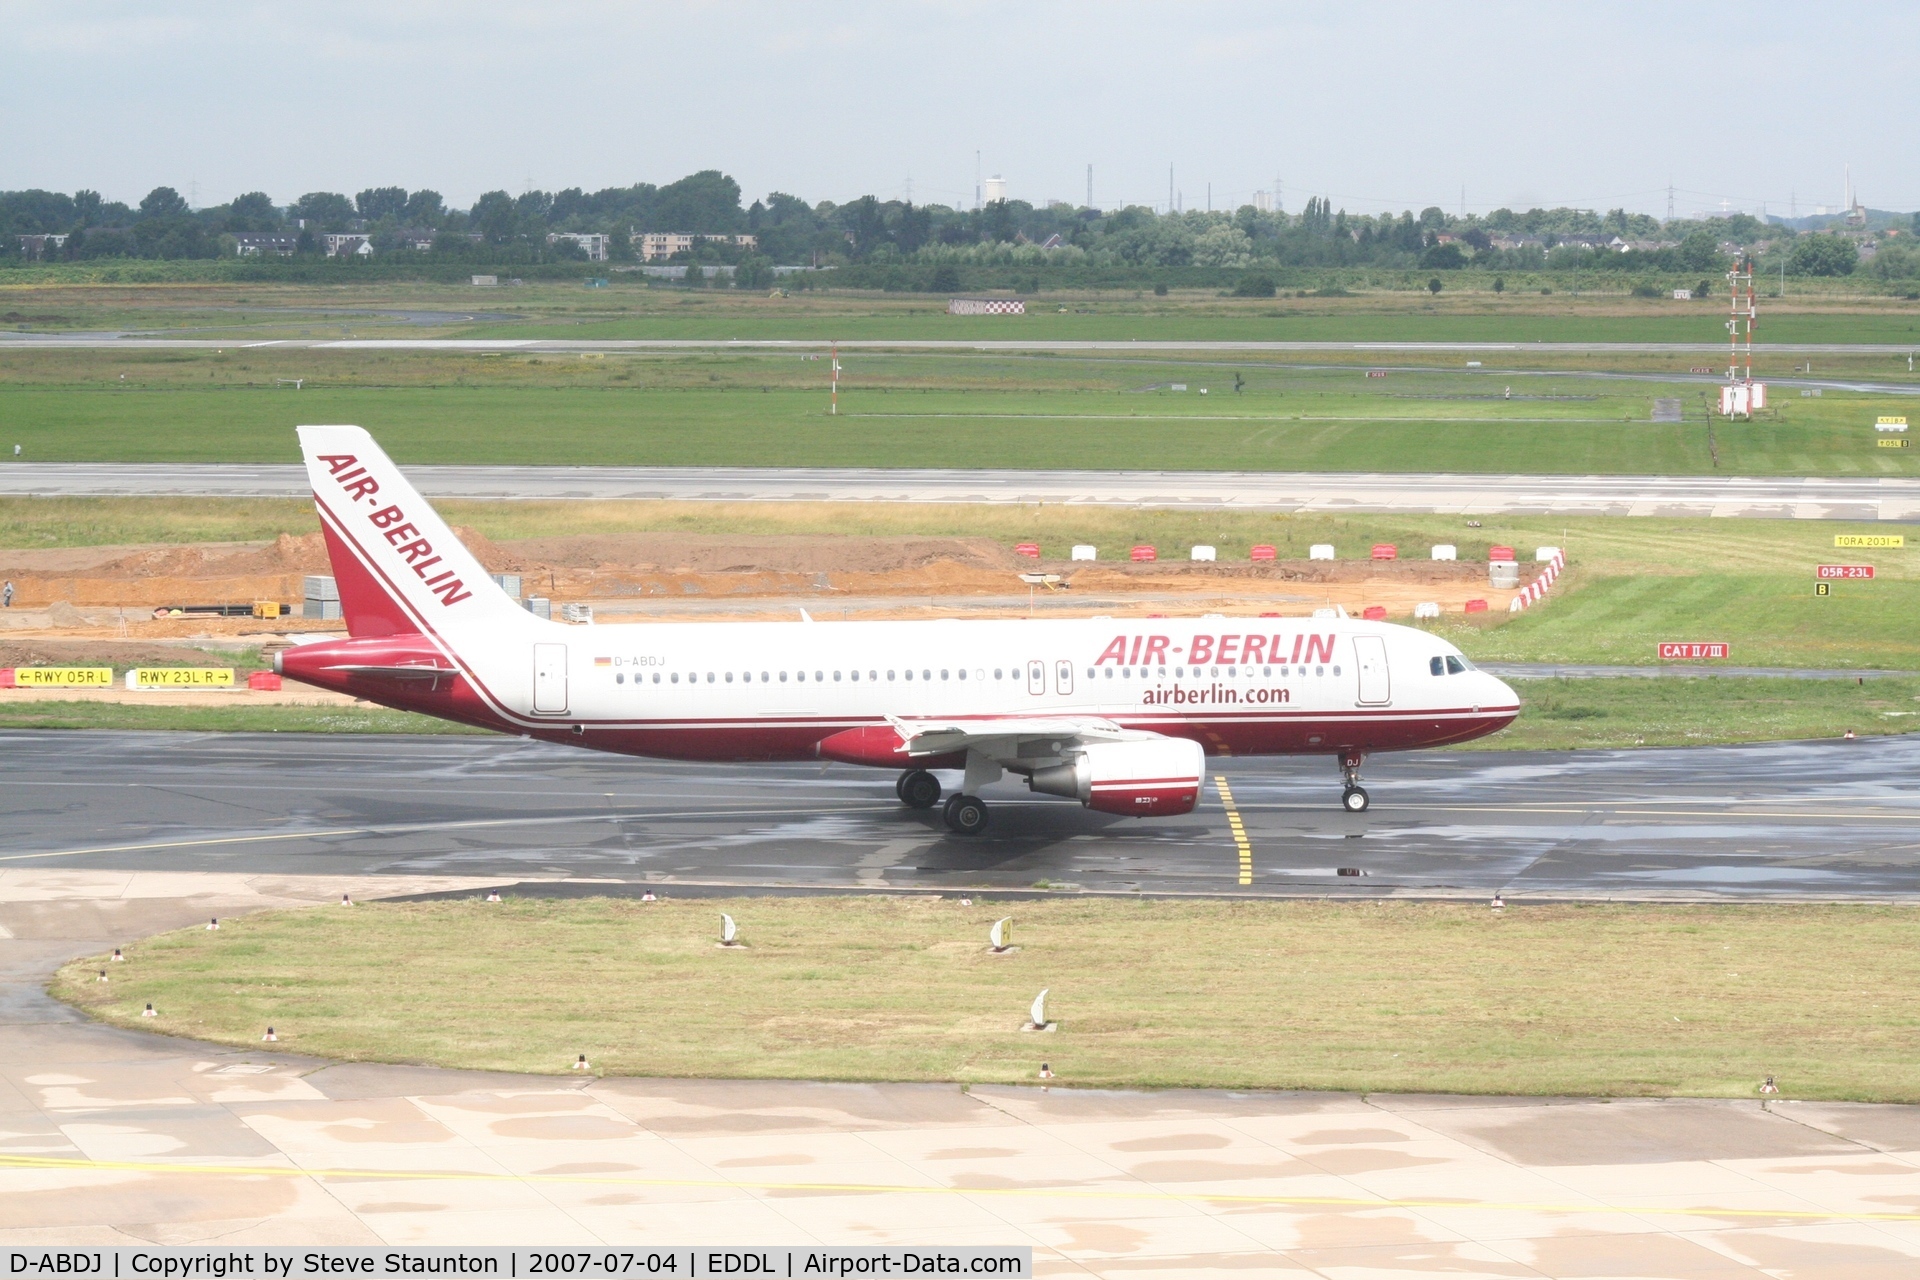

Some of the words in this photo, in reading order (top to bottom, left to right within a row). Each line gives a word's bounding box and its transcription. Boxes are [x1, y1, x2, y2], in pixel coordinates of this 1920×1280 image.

[1838, 537, 1864, 546] TORA
[1866, 537, 1890, 546] 2031
[1821, 567, 1870, 578] 05R-23L
[1819, 584, 1827, 595] B
[1663, 645, 1688, 657] CAT
[614, 656, 665, 667] D-ABDJ
[34, 671, 63, 683] RWY
[140, 671, 169, 683] RWY
[1142, 683, 1290, 705] airberlin.com
[1346, 758, 1359, 767] DJ
